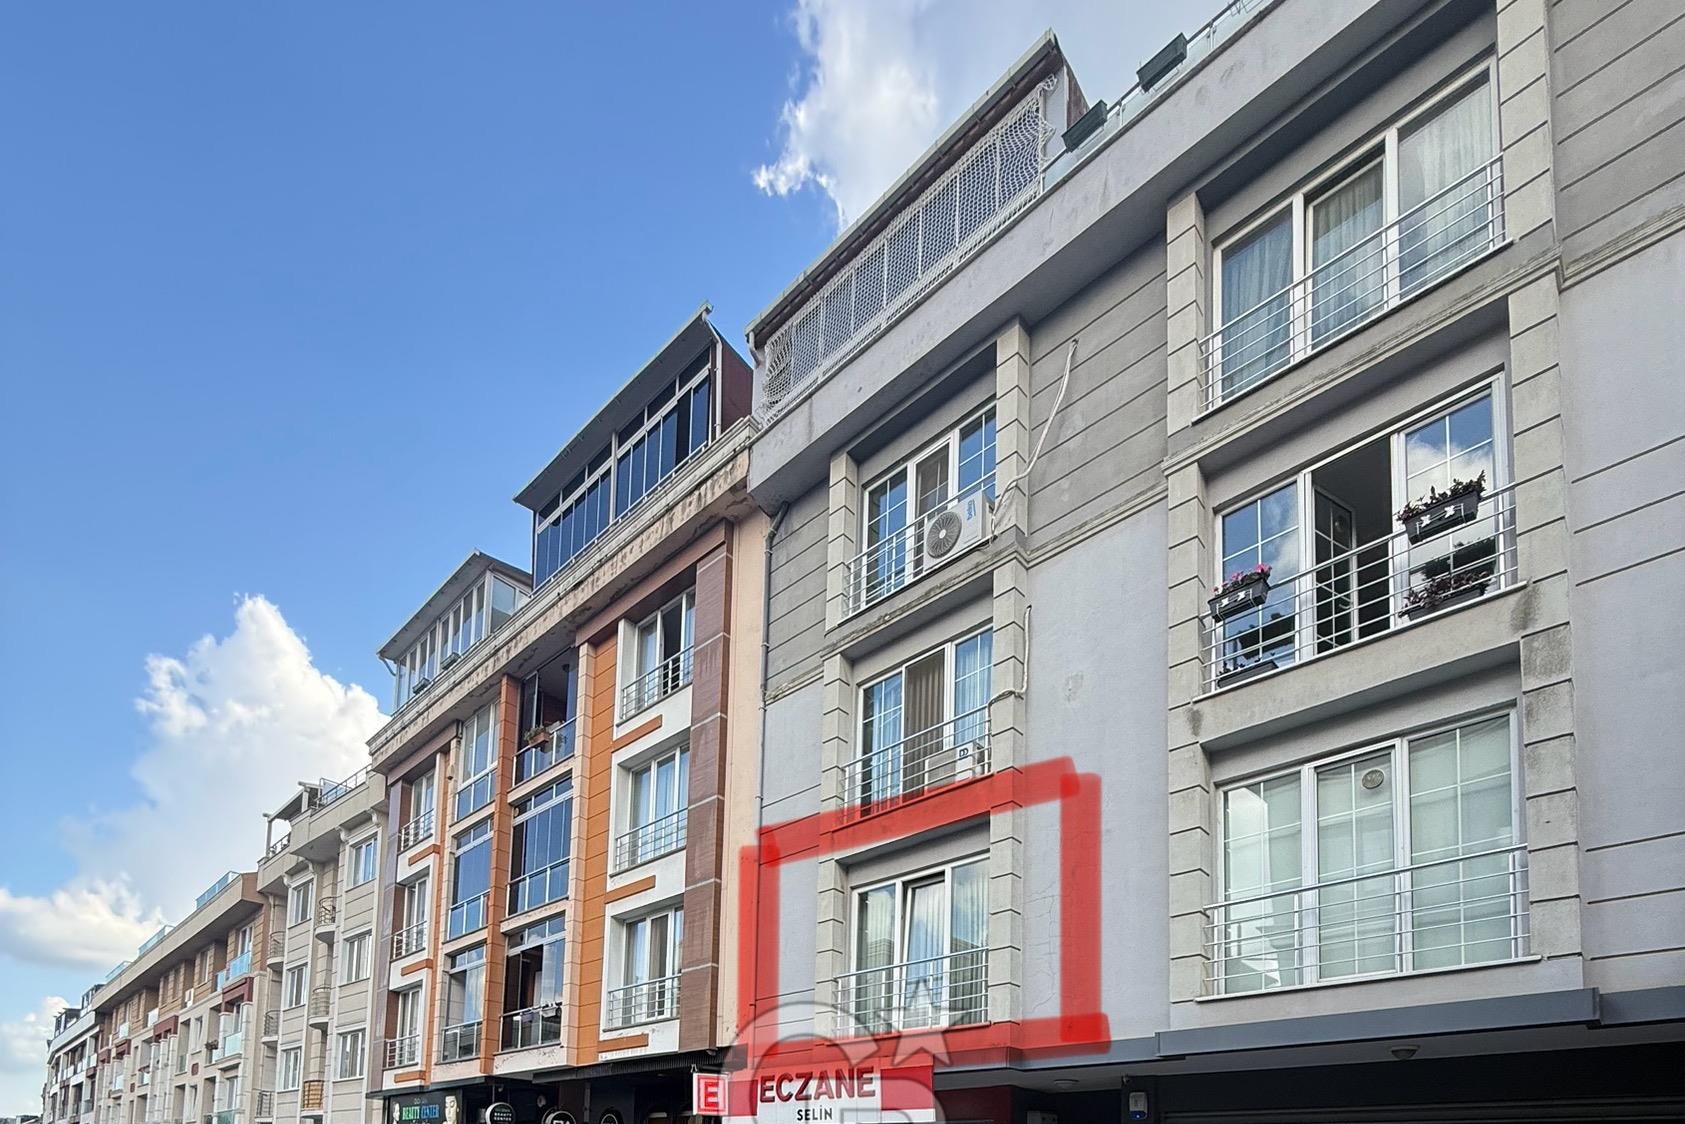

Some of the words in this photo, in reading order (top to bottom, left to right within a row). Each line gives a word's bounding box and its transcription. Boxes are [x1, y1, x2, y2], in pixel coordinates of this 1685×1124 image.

[704, 1081, 720, 1108] E
[759, 1066, 876, 1104] ECZANE
[797, 1104, 833, 1121] SELİN
